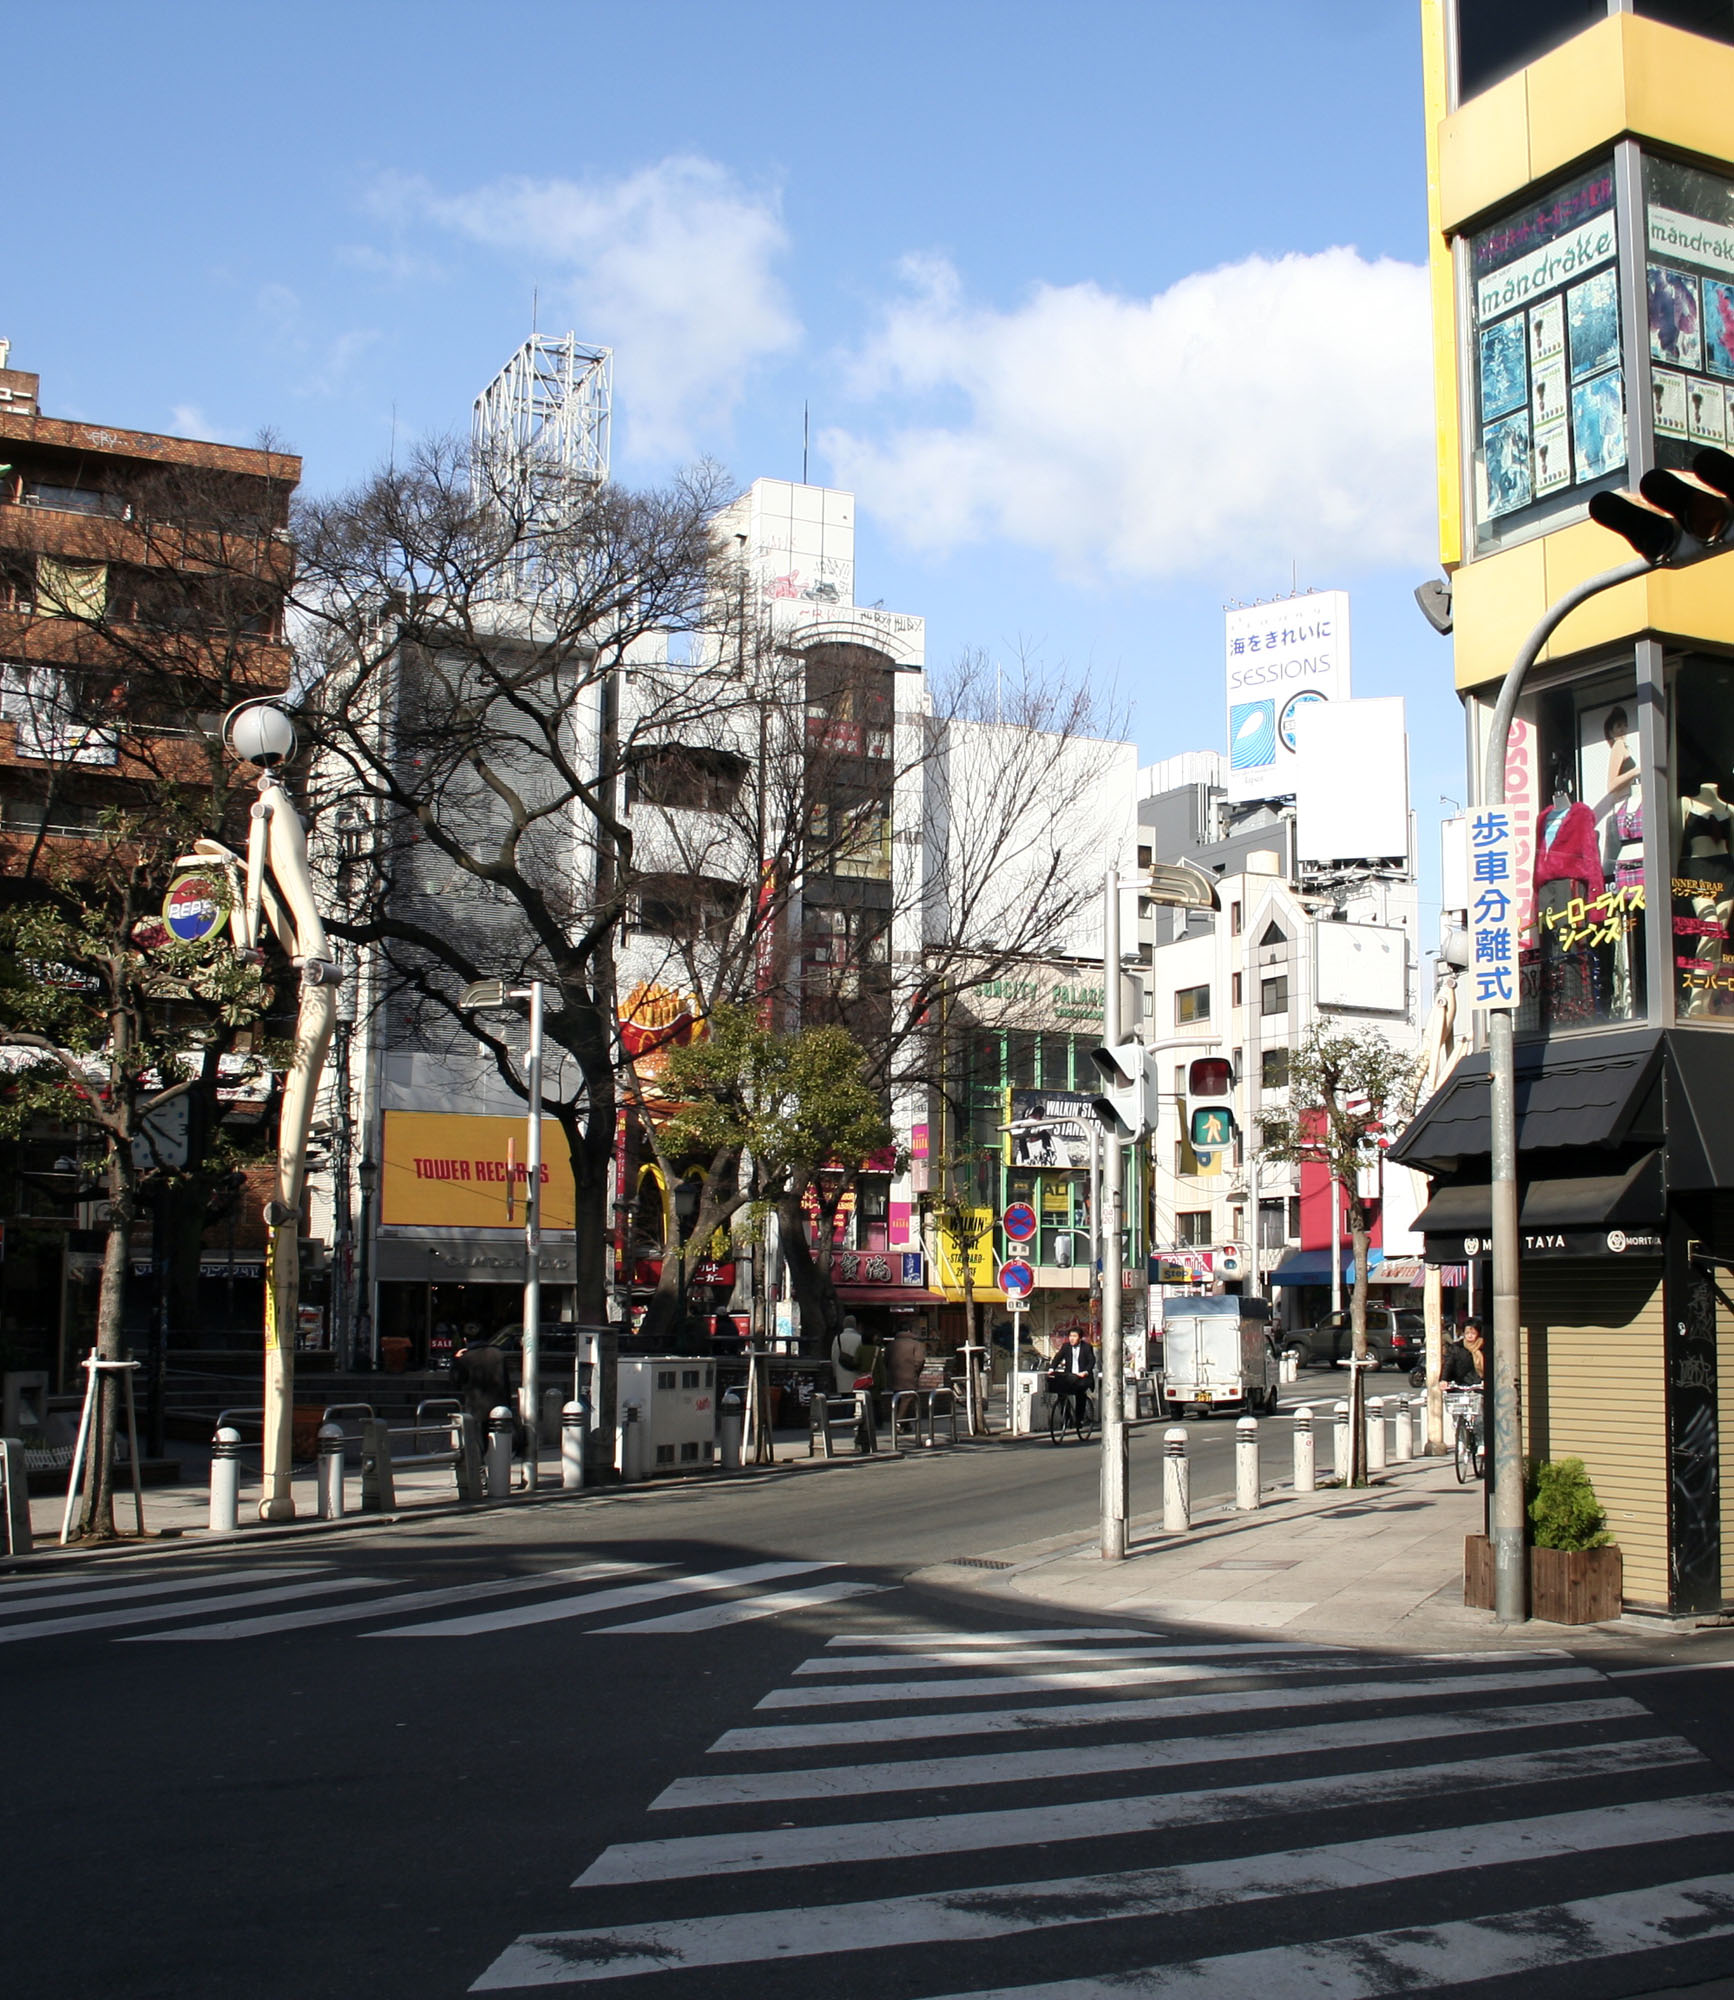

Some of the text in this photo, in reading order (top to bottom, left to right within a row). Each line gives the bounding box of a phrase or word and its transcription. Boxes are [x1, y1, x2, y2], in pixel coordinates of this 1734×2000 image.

[1230, 622, 1332, 656] 海をきれいに
[1230, 654, 1331, 689] SESSIONS
[1472, 812, 1513, 1001] 歩車分離式
[1559, 917, 1622, 952] ジーンズ
[413, 1158, 549, 1184] TOWER RECRS
